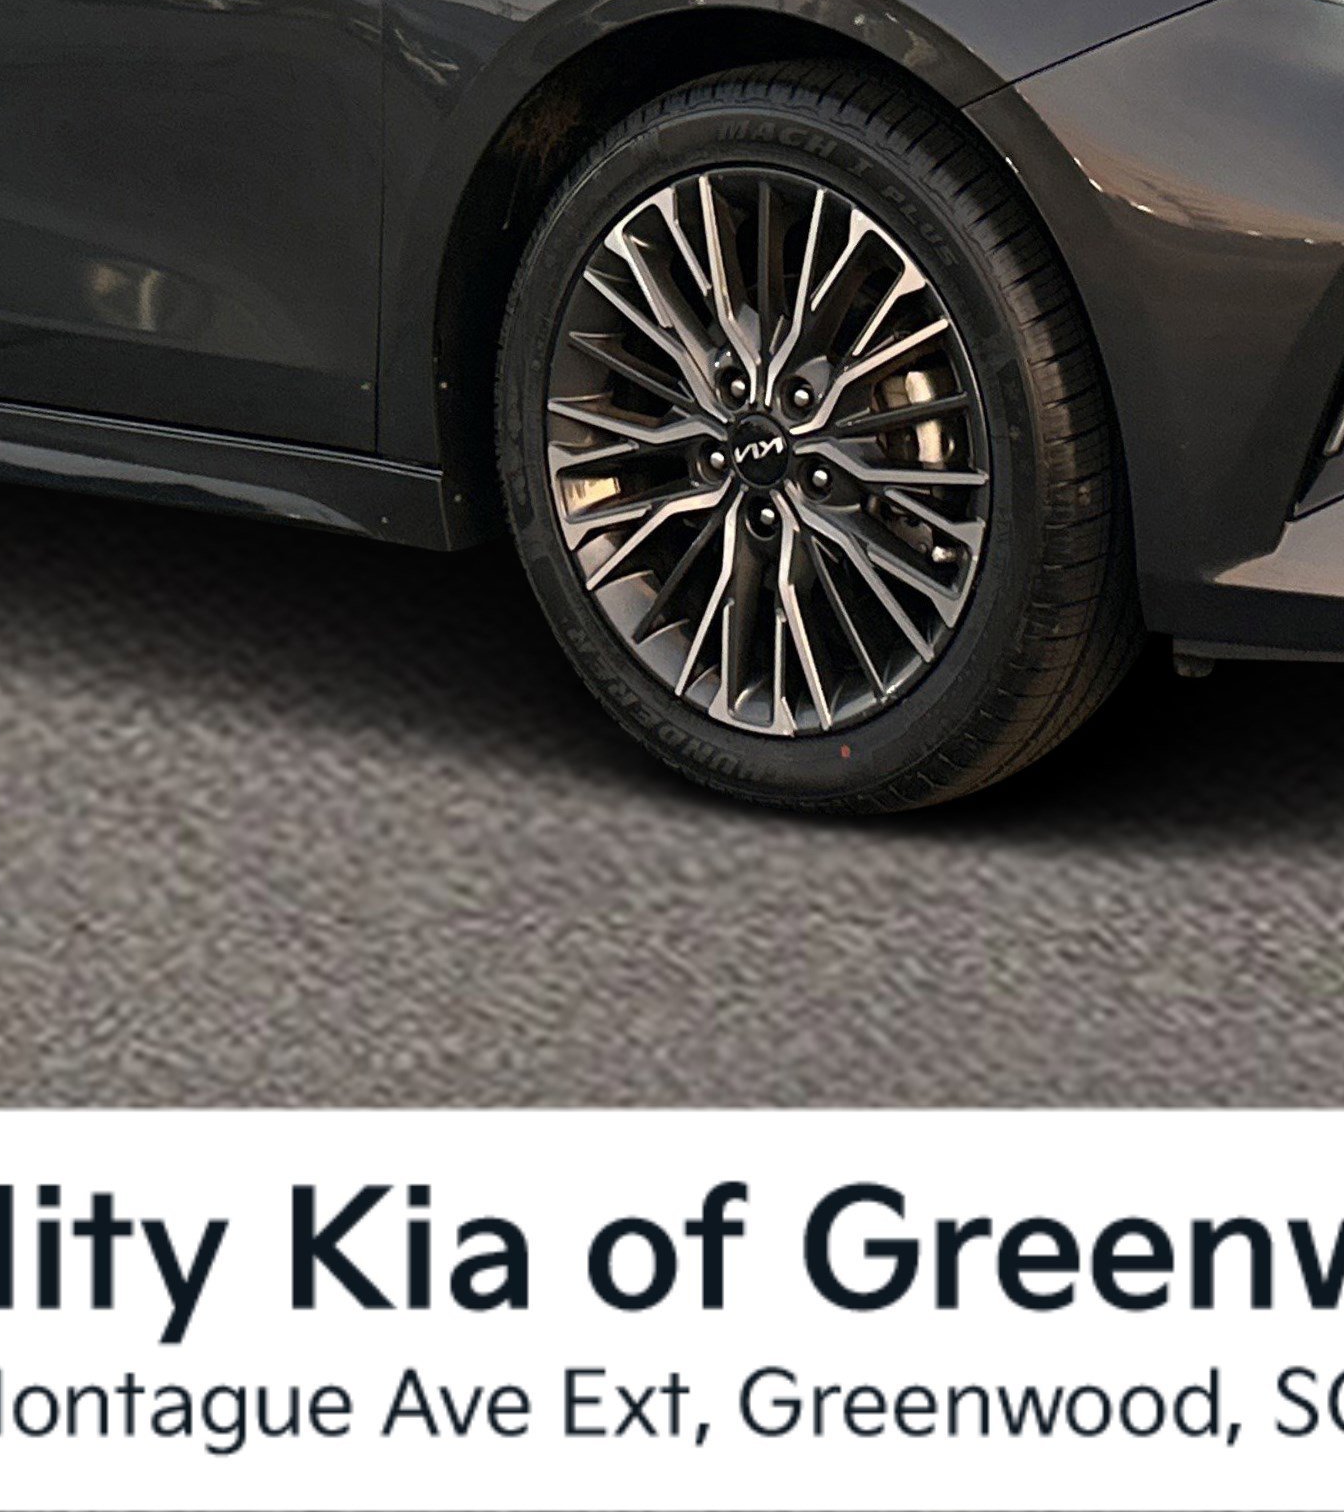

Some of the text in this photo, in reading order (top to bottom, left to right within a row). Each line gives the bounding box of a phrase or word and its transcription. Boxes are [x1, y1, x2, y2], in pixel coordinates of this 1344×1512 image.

[718, 119, 838, 158] MACH
[881, 185, 959, 267] PLUS
[565, 626, 784, 784] HUNDERER
